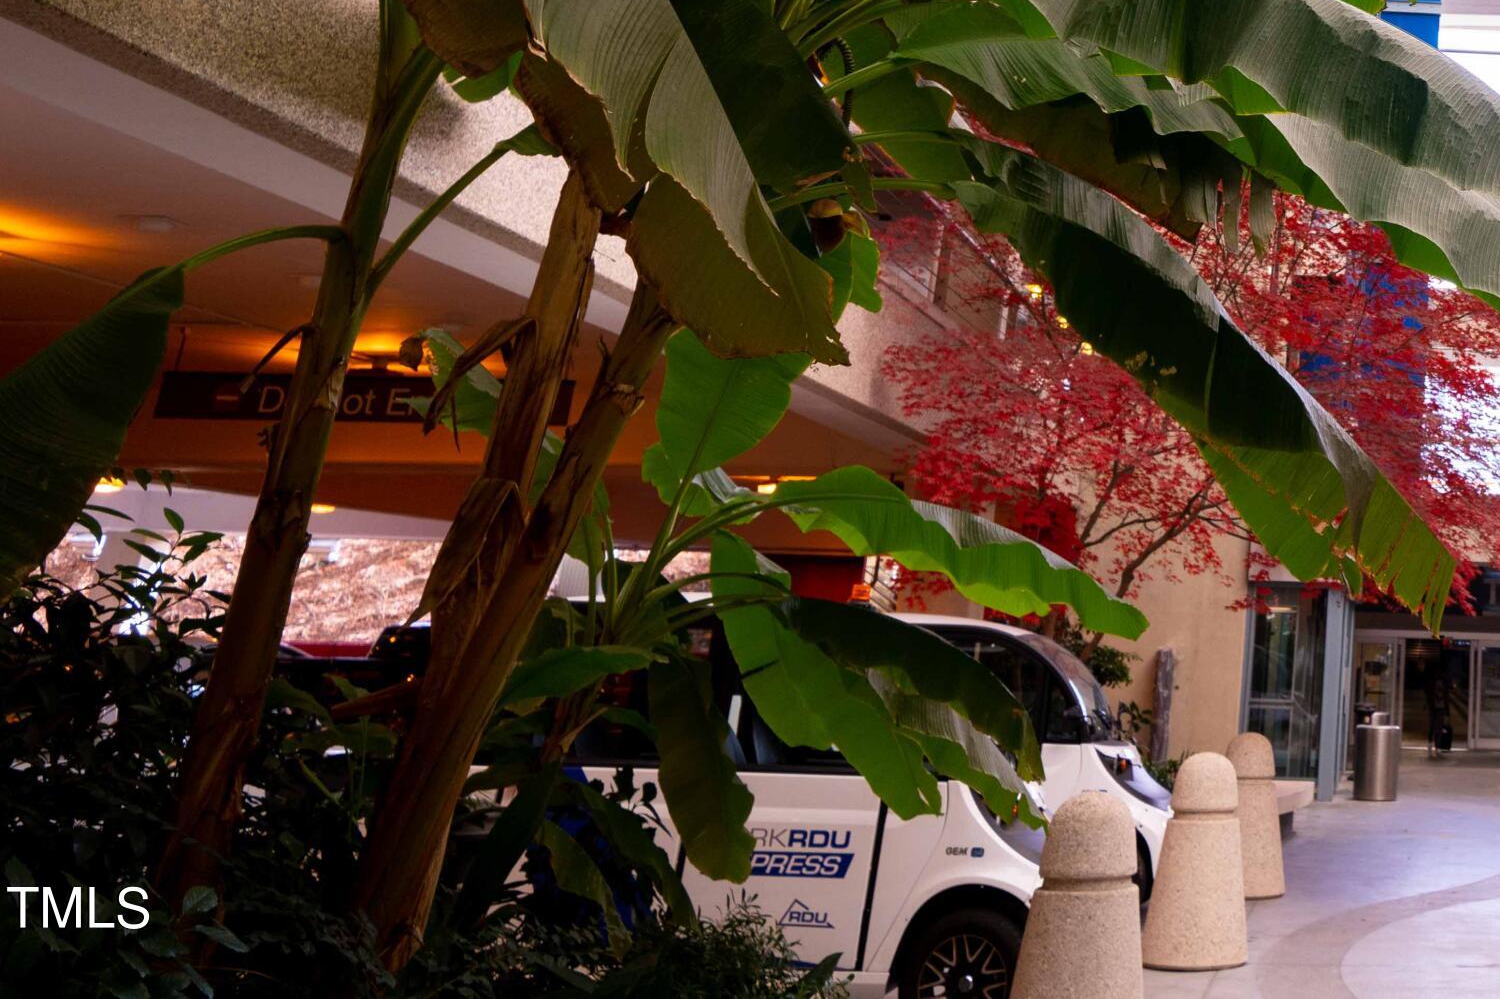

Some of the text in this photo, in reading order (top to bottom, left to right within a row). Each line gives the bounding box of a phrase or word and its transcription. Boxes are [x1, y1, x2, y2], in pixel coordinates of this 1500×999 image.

[257, 386, 287, 413] D
[751, 828, 852, 849] RKRDU
[751, 854, 842, 876] PRESS
[788, 911, 828, 924] RDU
